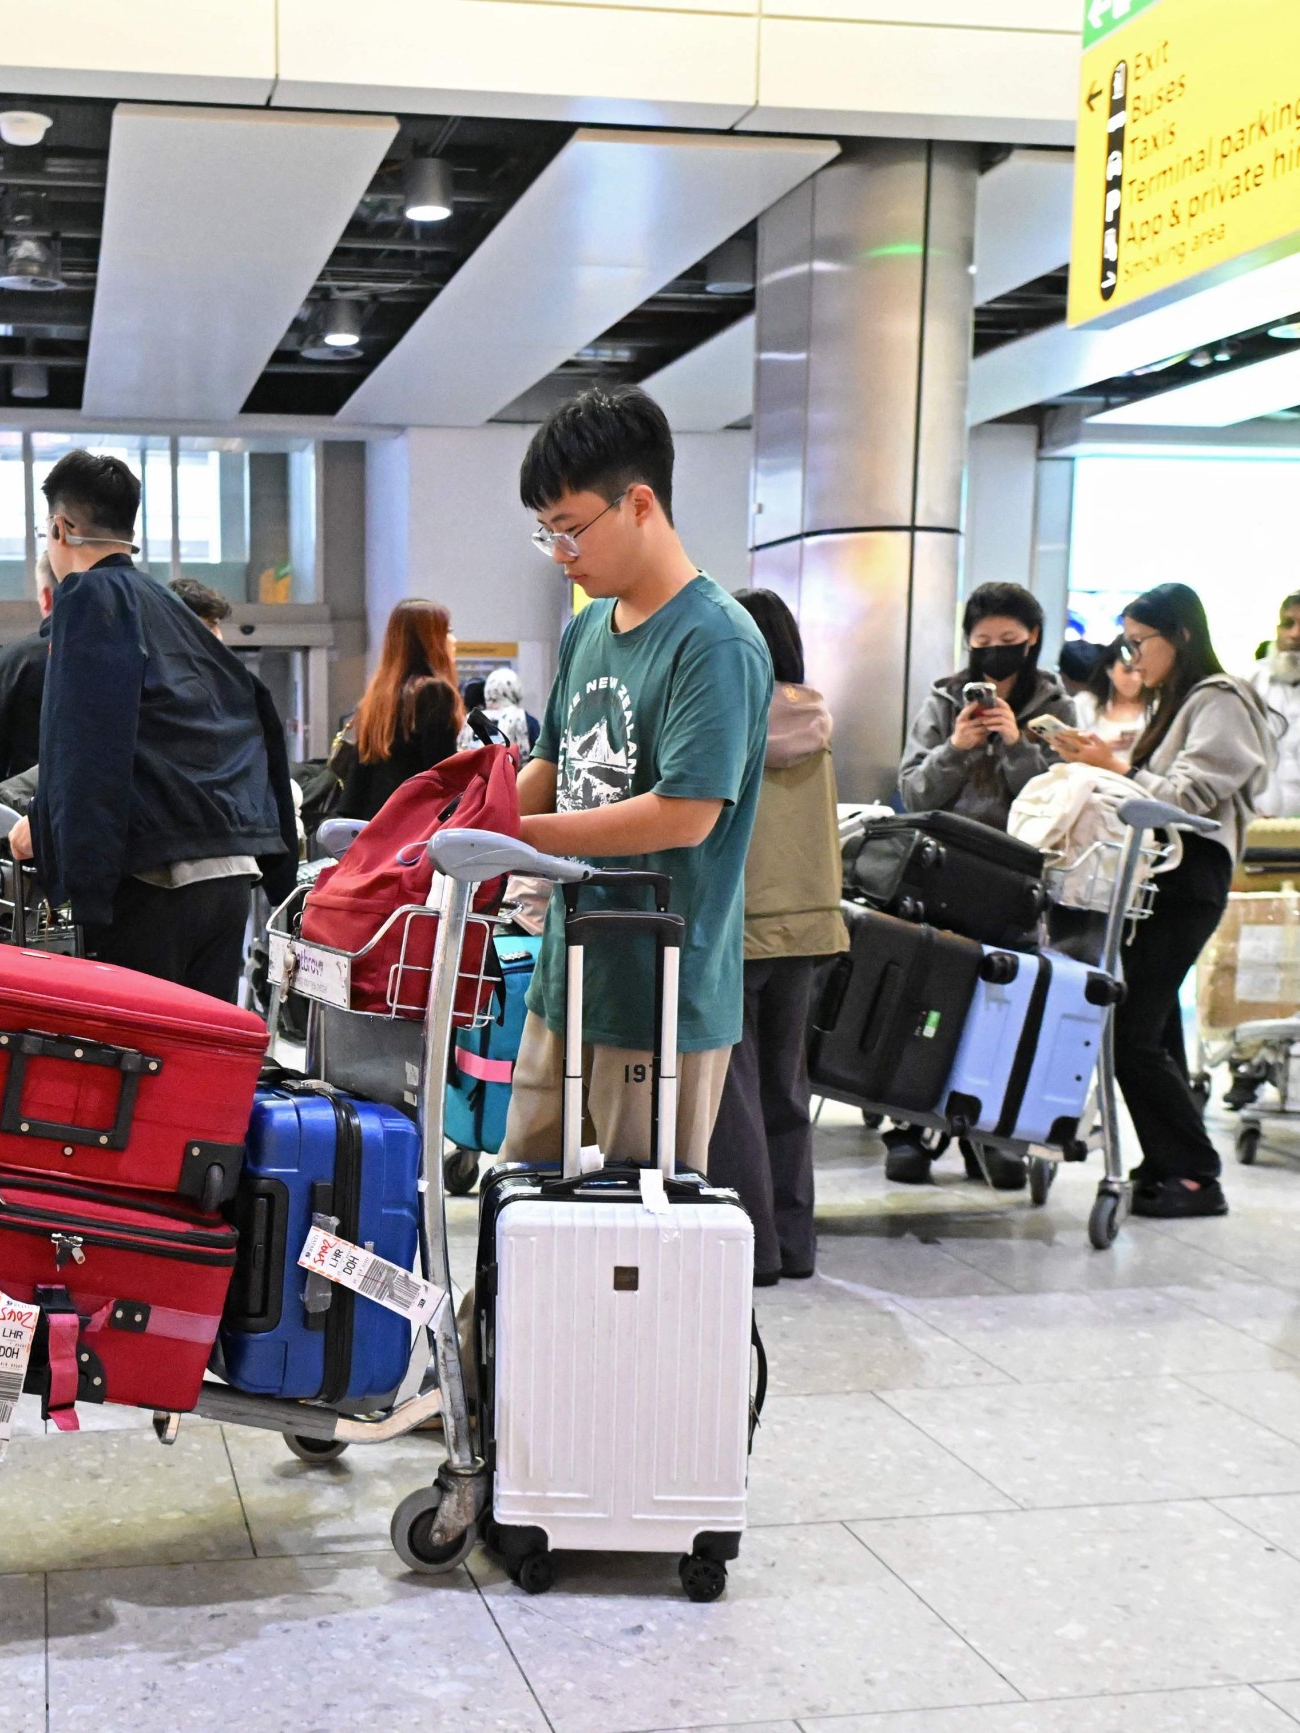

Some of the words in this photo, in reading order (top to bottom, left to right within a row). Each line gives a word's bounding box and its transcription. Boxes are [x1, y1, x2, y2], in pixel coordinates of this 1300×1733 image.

[1134, 40, 1169, 82] Exit
[1131, 74, 1186, 124] Buses
[1129, 119, 1177, 165] Taxis
[1128, 136, 1213, 207] Terminal
[1125, 213, 1163, 250] App
[1169, 199, 1181, 228] &
[1187, 163, 1265, 228] private
[1122, 241, 1187, 283] Smoking
[1191, 223, 1226, 252] area
[586, 676, 619, 694] NEW
[328, 1248, 344, 1269] LHR
[342, 1255, 360, 1276] DOH
[2, 1327, 24, 1340] LHR
